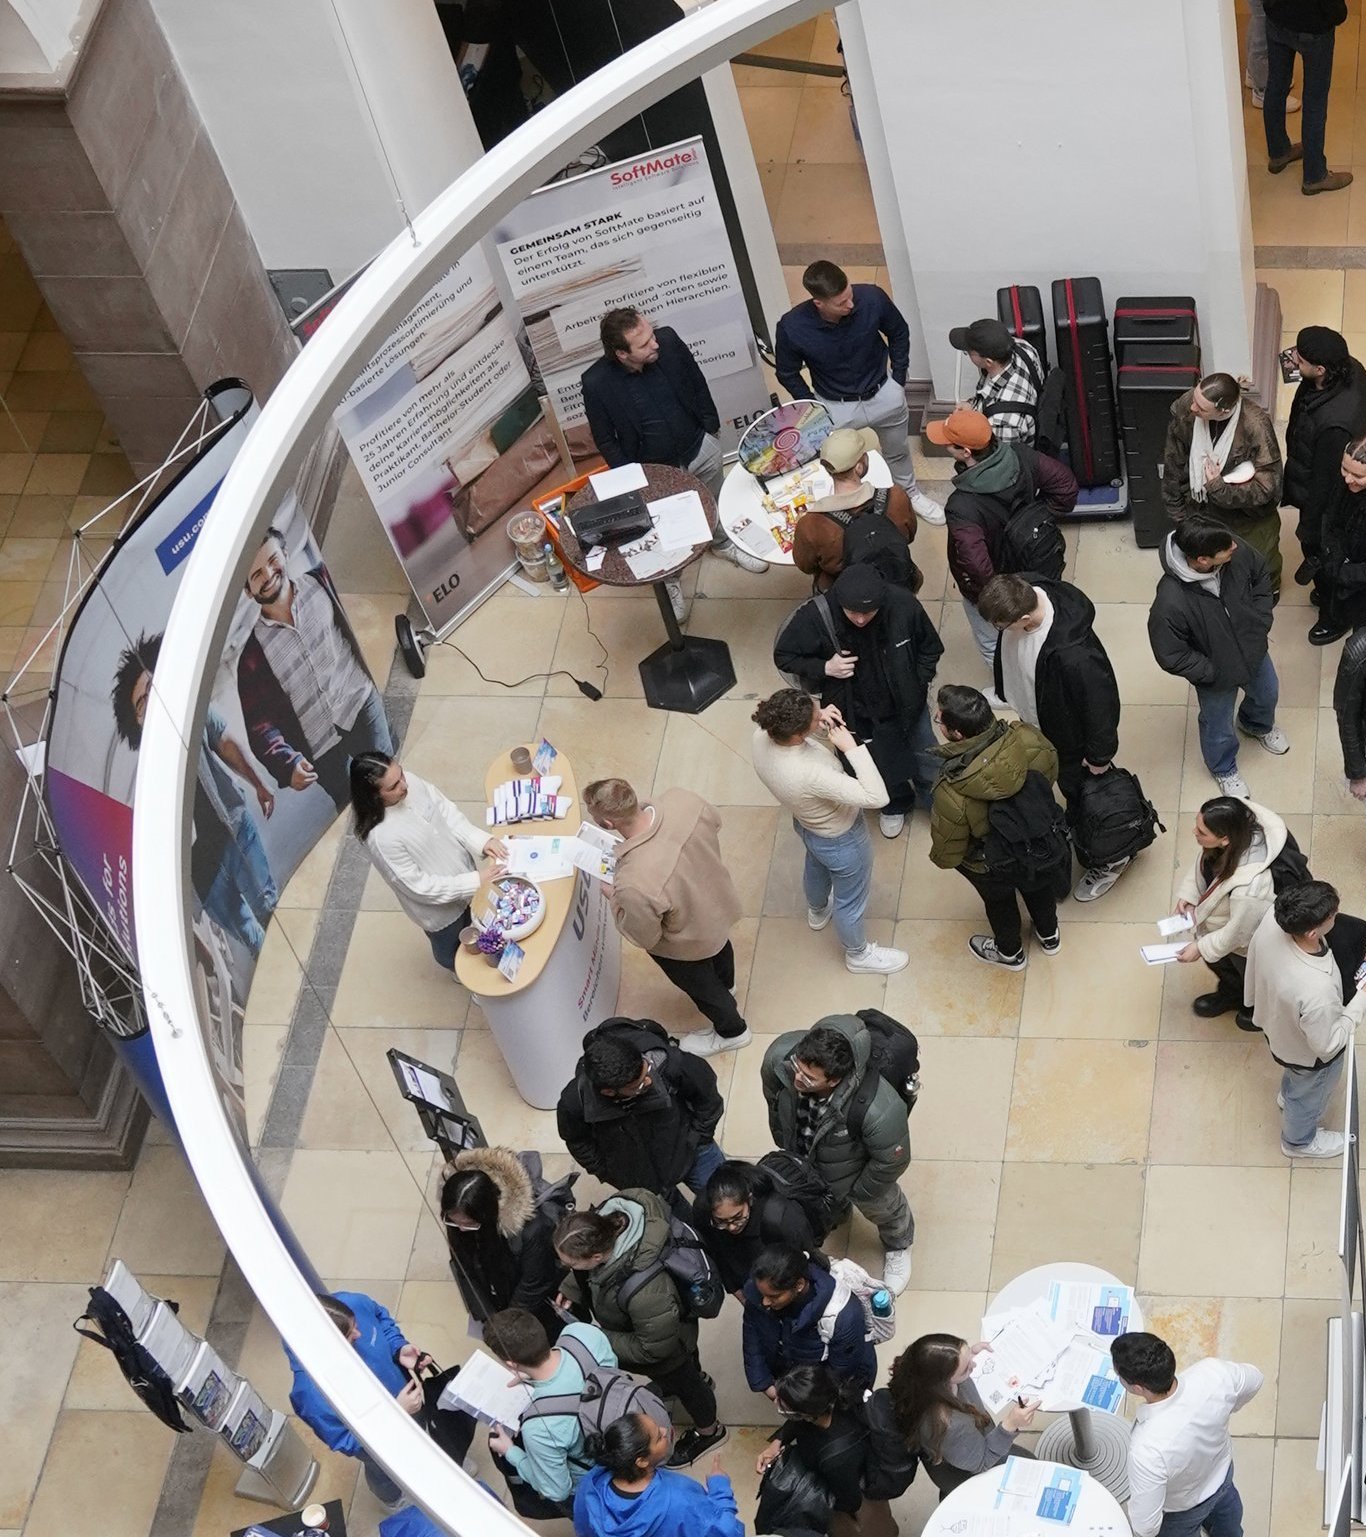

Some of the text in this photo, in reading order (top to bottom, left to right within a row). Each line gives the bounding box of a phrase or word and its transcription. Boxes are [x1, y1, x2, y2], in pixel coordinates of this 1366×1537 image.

[611, 153, 692, 185] SoftMate
[510, 211, 623, 255] GEMEINSAM STARK
[513, 195, 706, 266] Der Erfolg von SoftMate basiert auf
[517, 208, 702, 276] einem Team, das sich gegenseitig
[456, 276, 473, 294] und
[521, 259, 586, 286] unterstützt.
[604, 263, 726, 307] Profitiere von flexiblen
[638, 294, 659, 307] und
[662, 283, 695, 298] -orten
[697, 273, 728, 287] sowie
[666, 284, 731, 307] Hierarchien.
[359, 370, 456, 452] Profitiere von mehr als
[363, 340, 505, 463] 25 Jahren Erfahrung und entdecke
[368, 359, 499, 473] deine Karrieremöglichkeiten als
[421, 377, 493, 442] Bachelor-Student
[494, 361, 512, 379] oder
[378, 428, 453, 493] Junior Consultant
[432, 573, 460, 604] ELO
[103, 852, 114, 898] for
